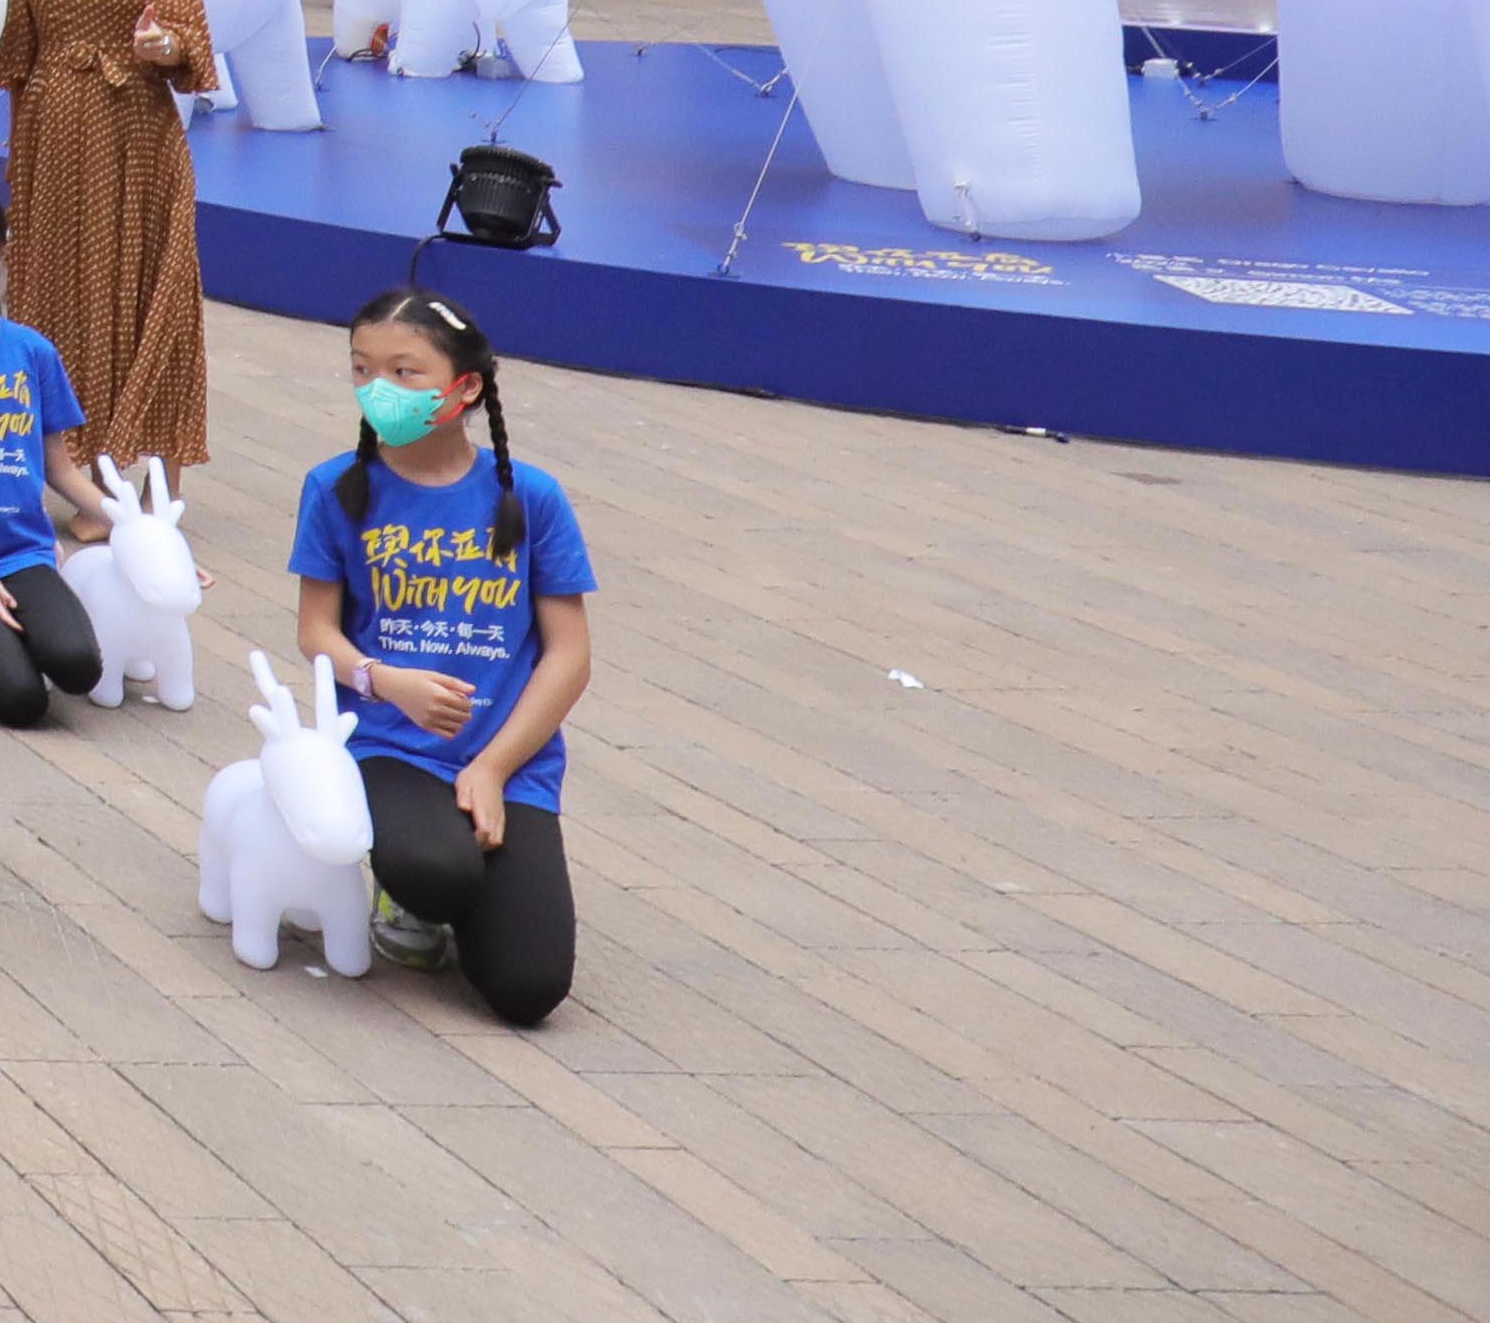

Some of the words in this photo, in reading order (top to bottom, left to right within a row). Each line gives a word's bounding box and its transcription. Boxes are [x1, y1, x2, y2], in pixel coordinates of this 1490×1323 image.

[378, 636, 416, 654] Then.
[420, 639, 453, 655] Now.
[456, 641, 510, 661] Always.
